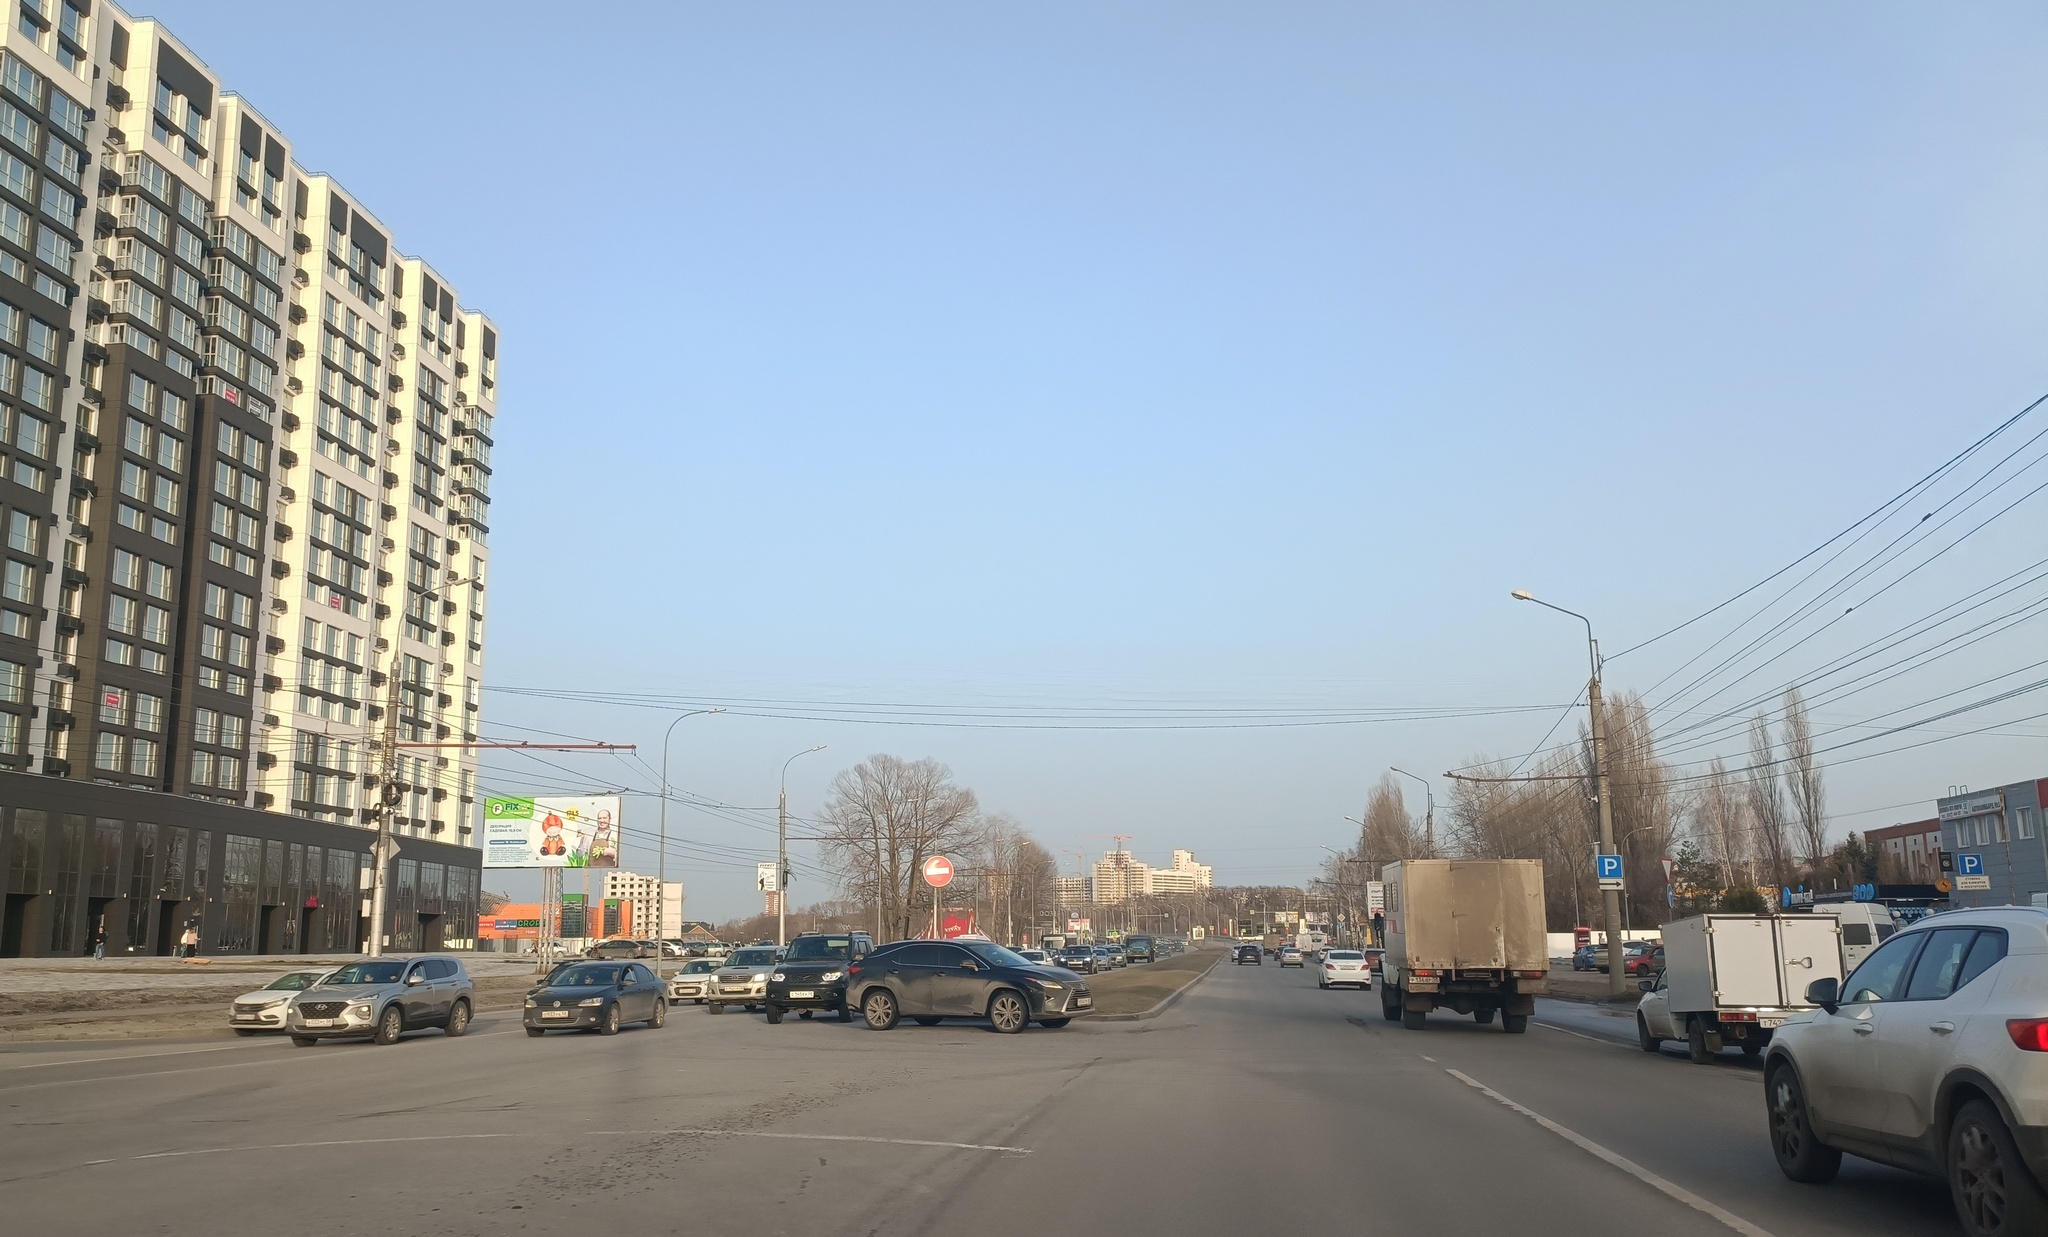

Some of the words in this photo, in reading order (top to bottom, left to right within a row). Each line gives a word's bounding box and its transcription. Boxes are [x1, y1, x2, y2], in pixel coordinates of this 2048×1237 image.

[505, 803, 519, 811] FIX
[1604, 858, 1618, 875] P
[1964, 856, 1978, 873] P
